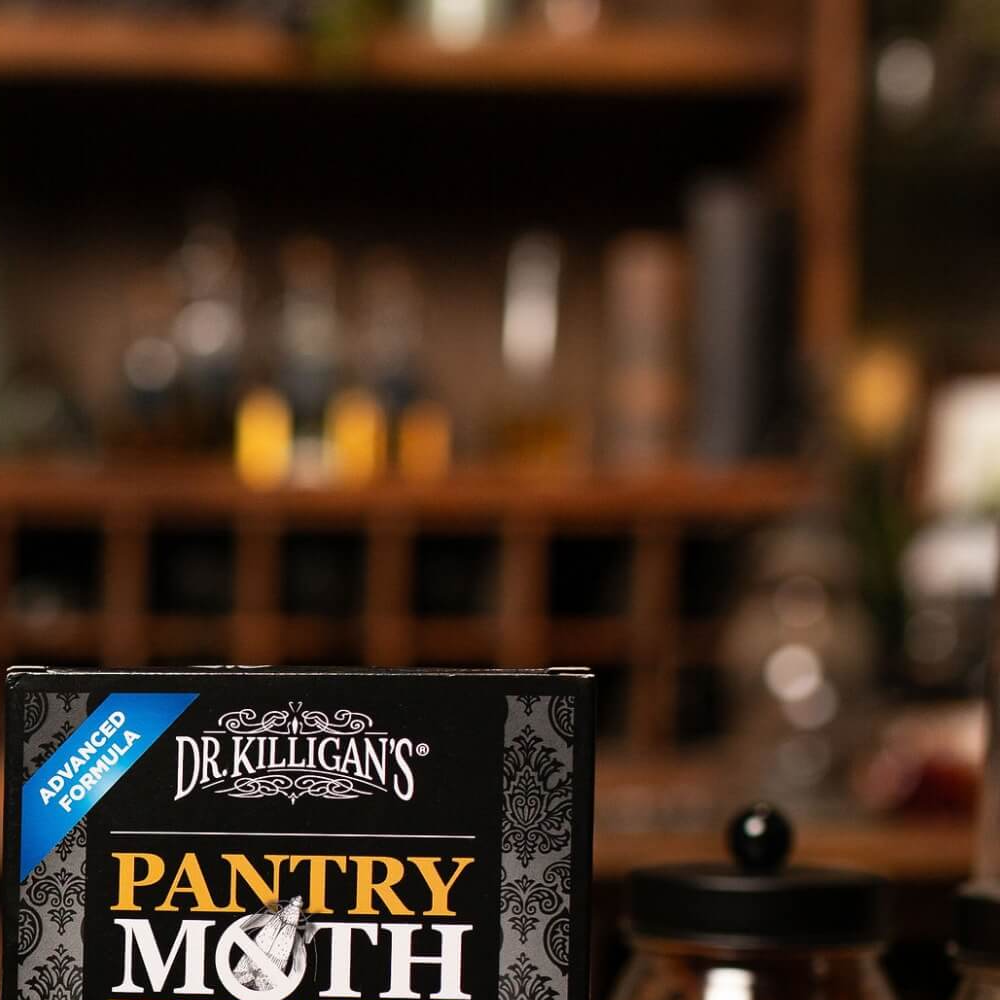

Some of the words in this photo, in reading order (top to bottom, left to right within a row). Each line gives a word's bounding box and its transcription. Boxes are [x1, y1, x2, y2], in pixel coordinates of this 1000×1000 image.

[39, 710, 127, 805] ADVANCED
[58, 729, 141, 813] FORMULA
[110, 852, 475, 916] PANTRY
